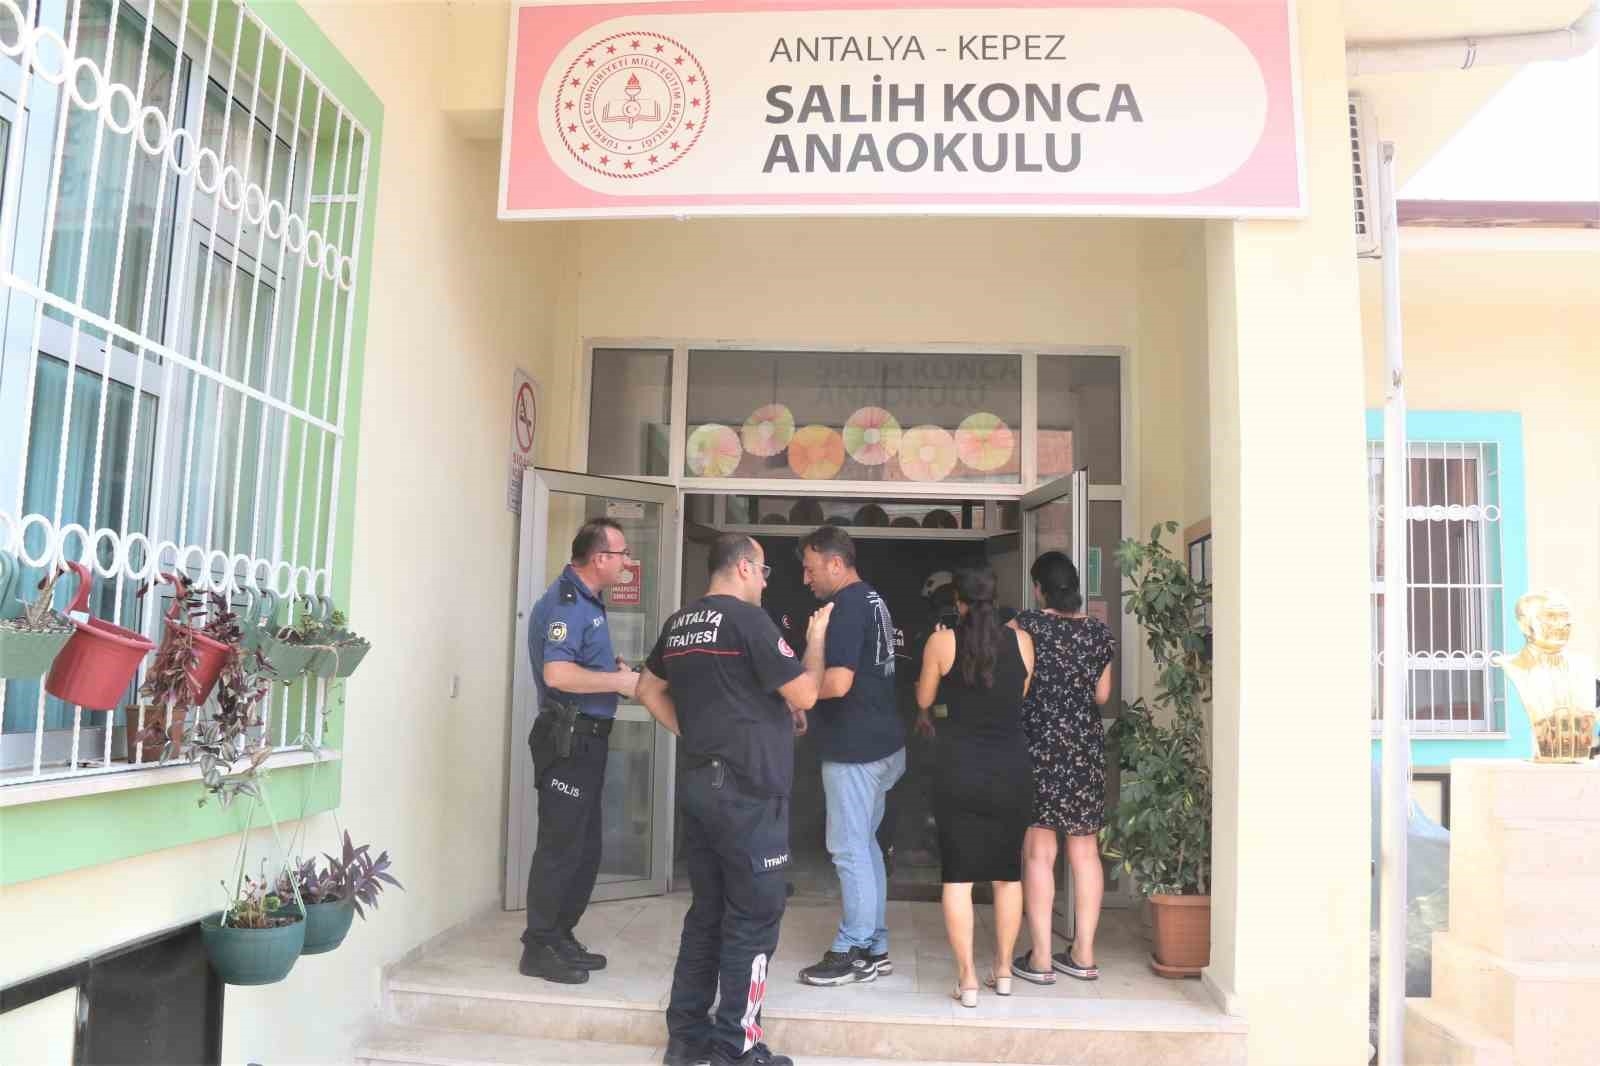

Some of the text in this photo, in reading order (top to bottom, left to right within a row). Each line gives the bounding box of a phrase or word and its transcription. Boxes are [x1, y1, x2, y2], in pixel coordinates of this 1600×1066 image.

[769, 35, 925, 62] ANTALYA
[959, 34, 1066, 60] KEPEZ
[764, 74, 1143, 124] SALİH KONCA
[761, 133, 1081, 173] ANAOKULU
[671, 609, 723, 632] ANTALYA
